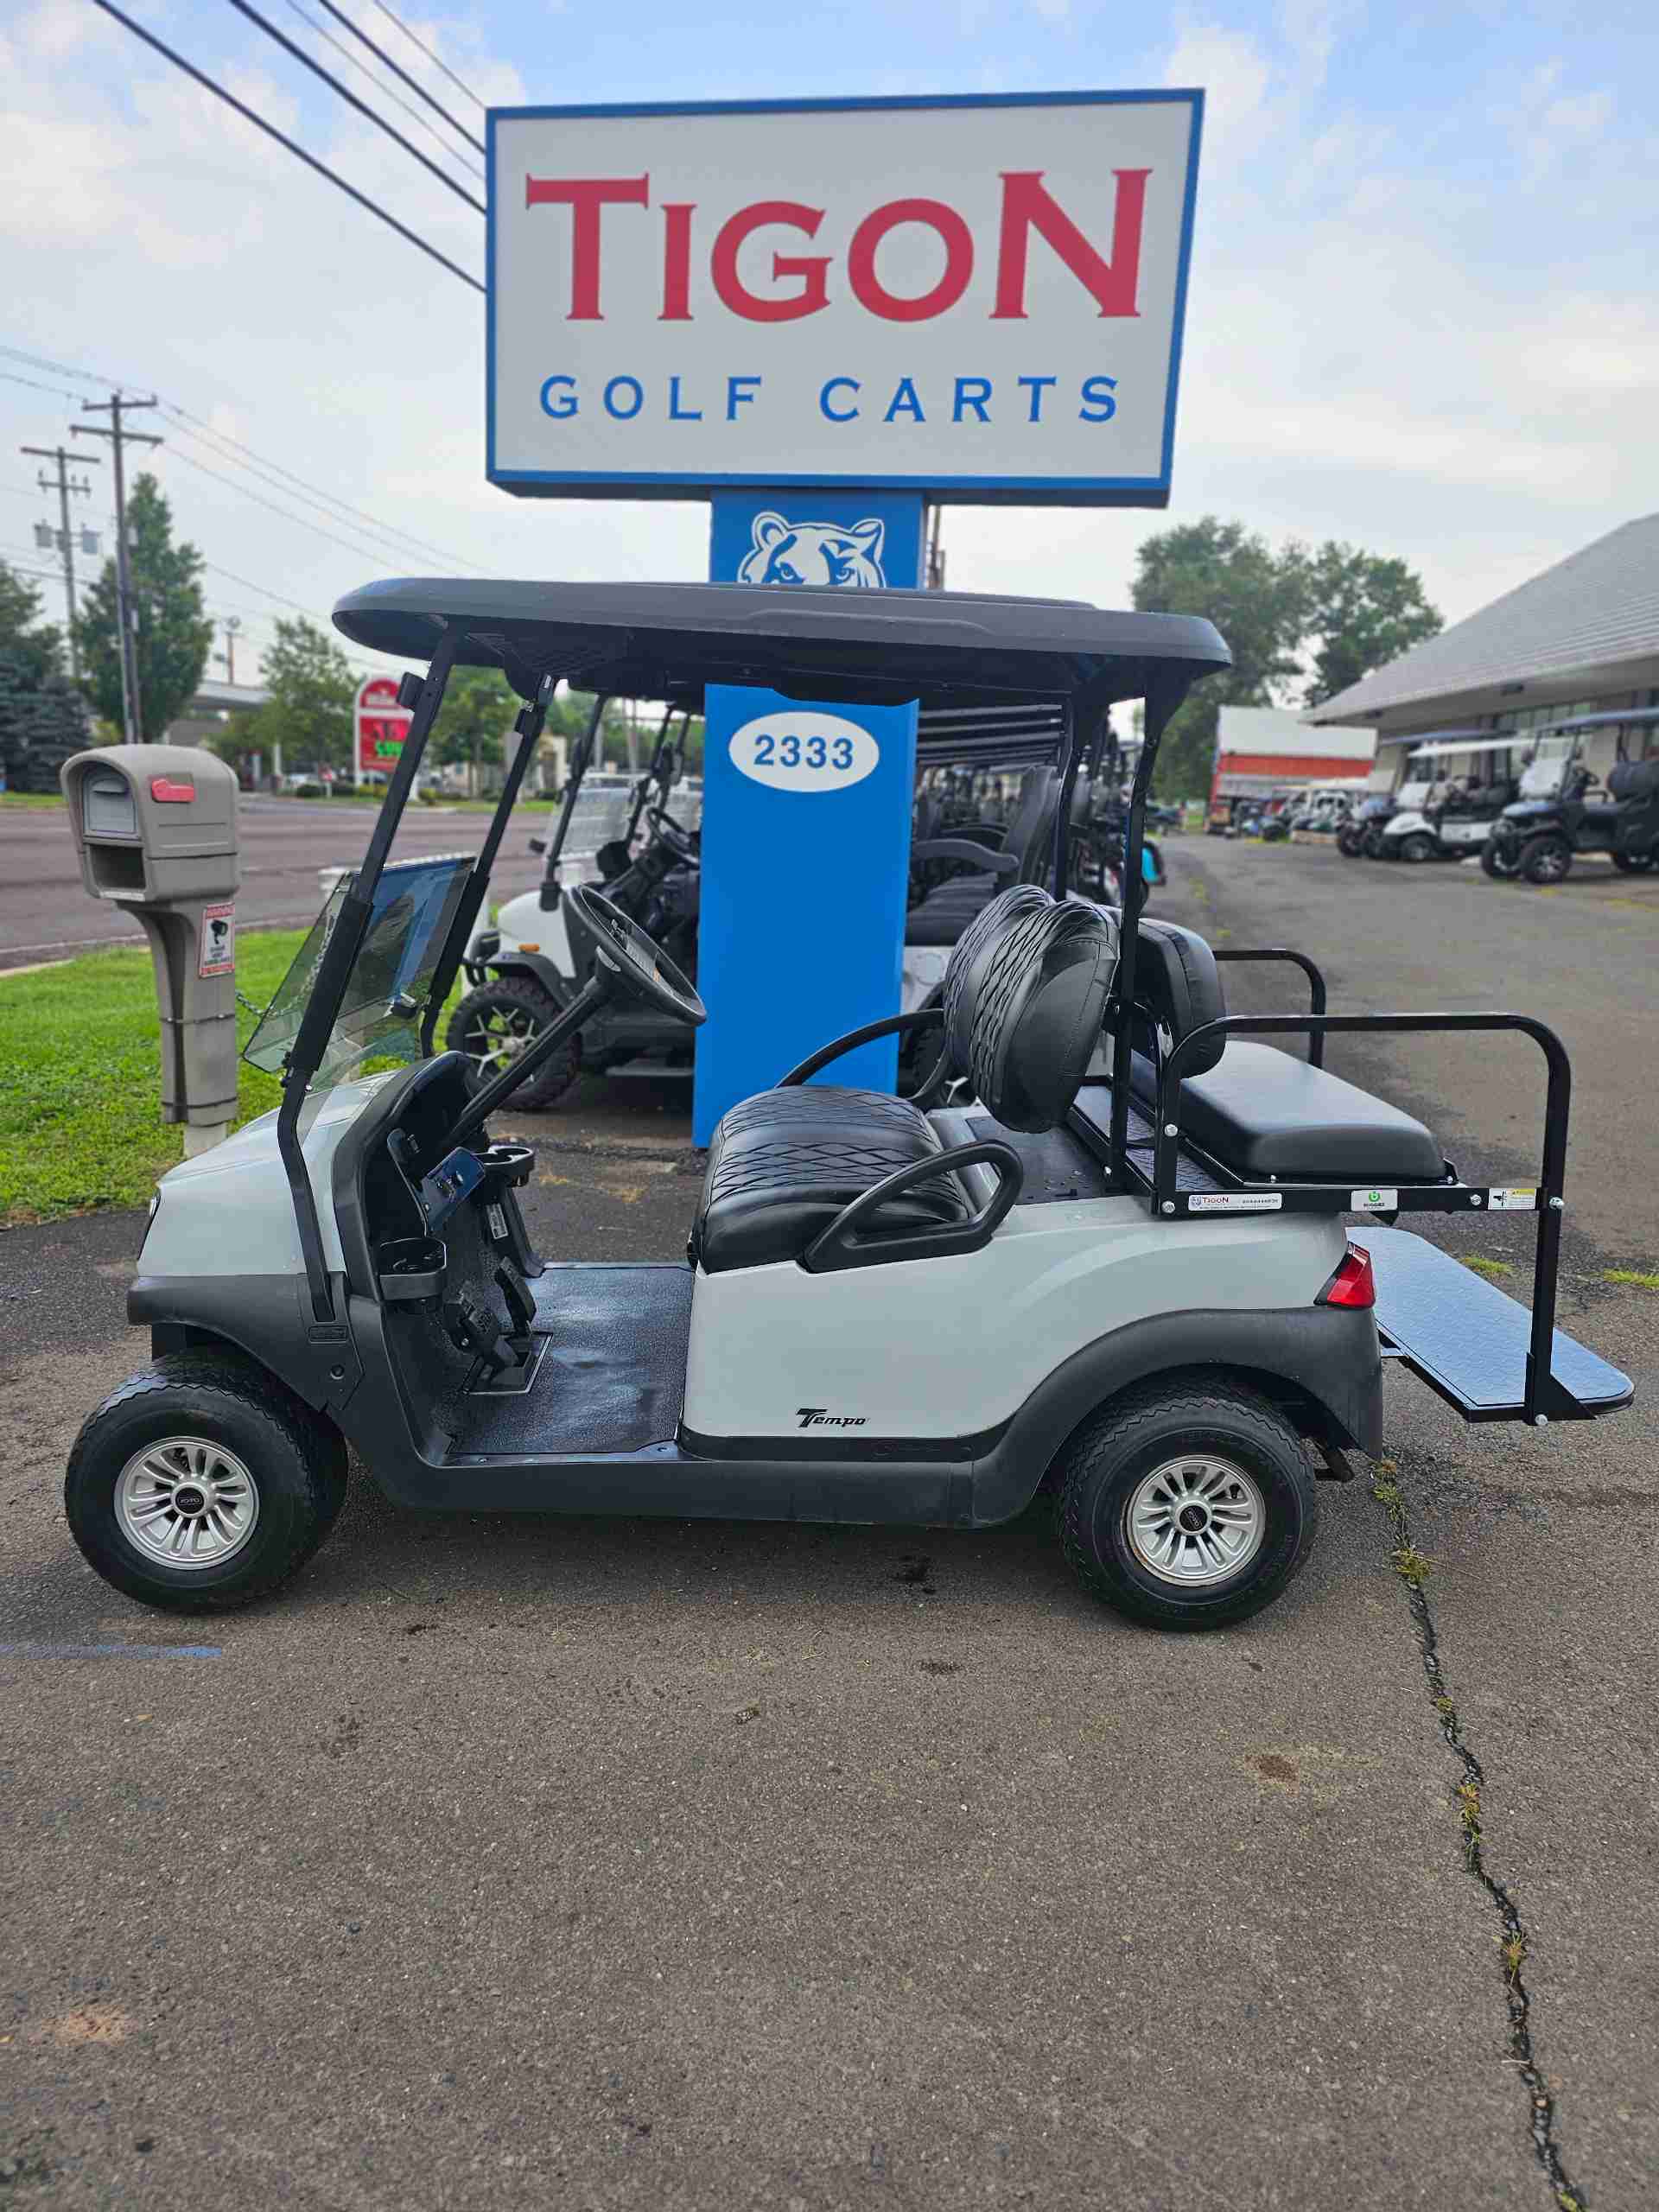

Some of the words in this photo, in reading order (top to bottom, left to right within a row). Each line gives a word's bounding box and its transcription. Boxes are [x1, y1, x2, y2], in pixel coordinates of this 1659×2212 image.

[525, 168, 1154, 322] TIGON
[539, 374, 762, 423] GOLF
[819, 374, 1119, 424] CARTS
[753, 734, 854, 770] 2333
[796, 1408, 867, 1428] Tempo
